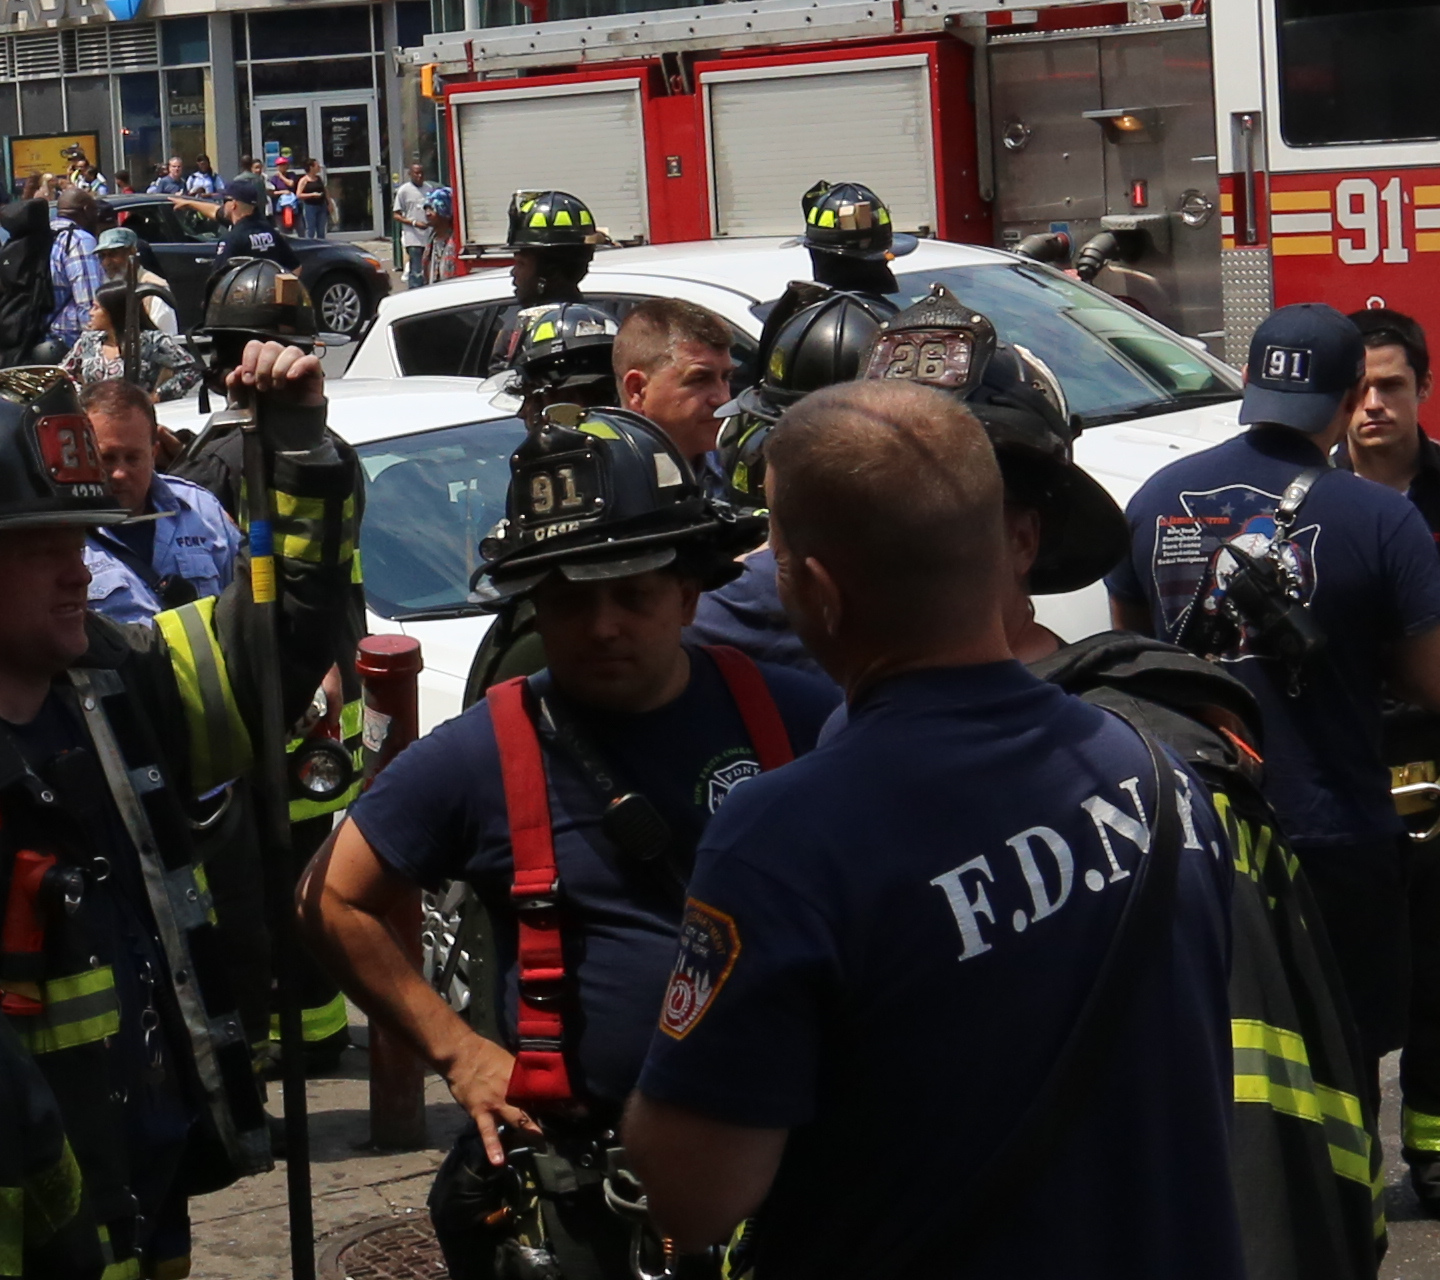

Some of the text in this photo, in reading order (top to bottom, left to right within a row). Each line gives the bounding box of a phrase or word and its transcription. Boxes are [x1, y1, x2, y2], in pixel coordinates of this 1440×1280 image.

[171, 101, 205, 116] CHAS
[1334, 177, 1412, 265] 91
[1269, 349, 1301, 378] 91
[532, 468, 583, 514] 91
[724, 765, 761, 782] FDNY
